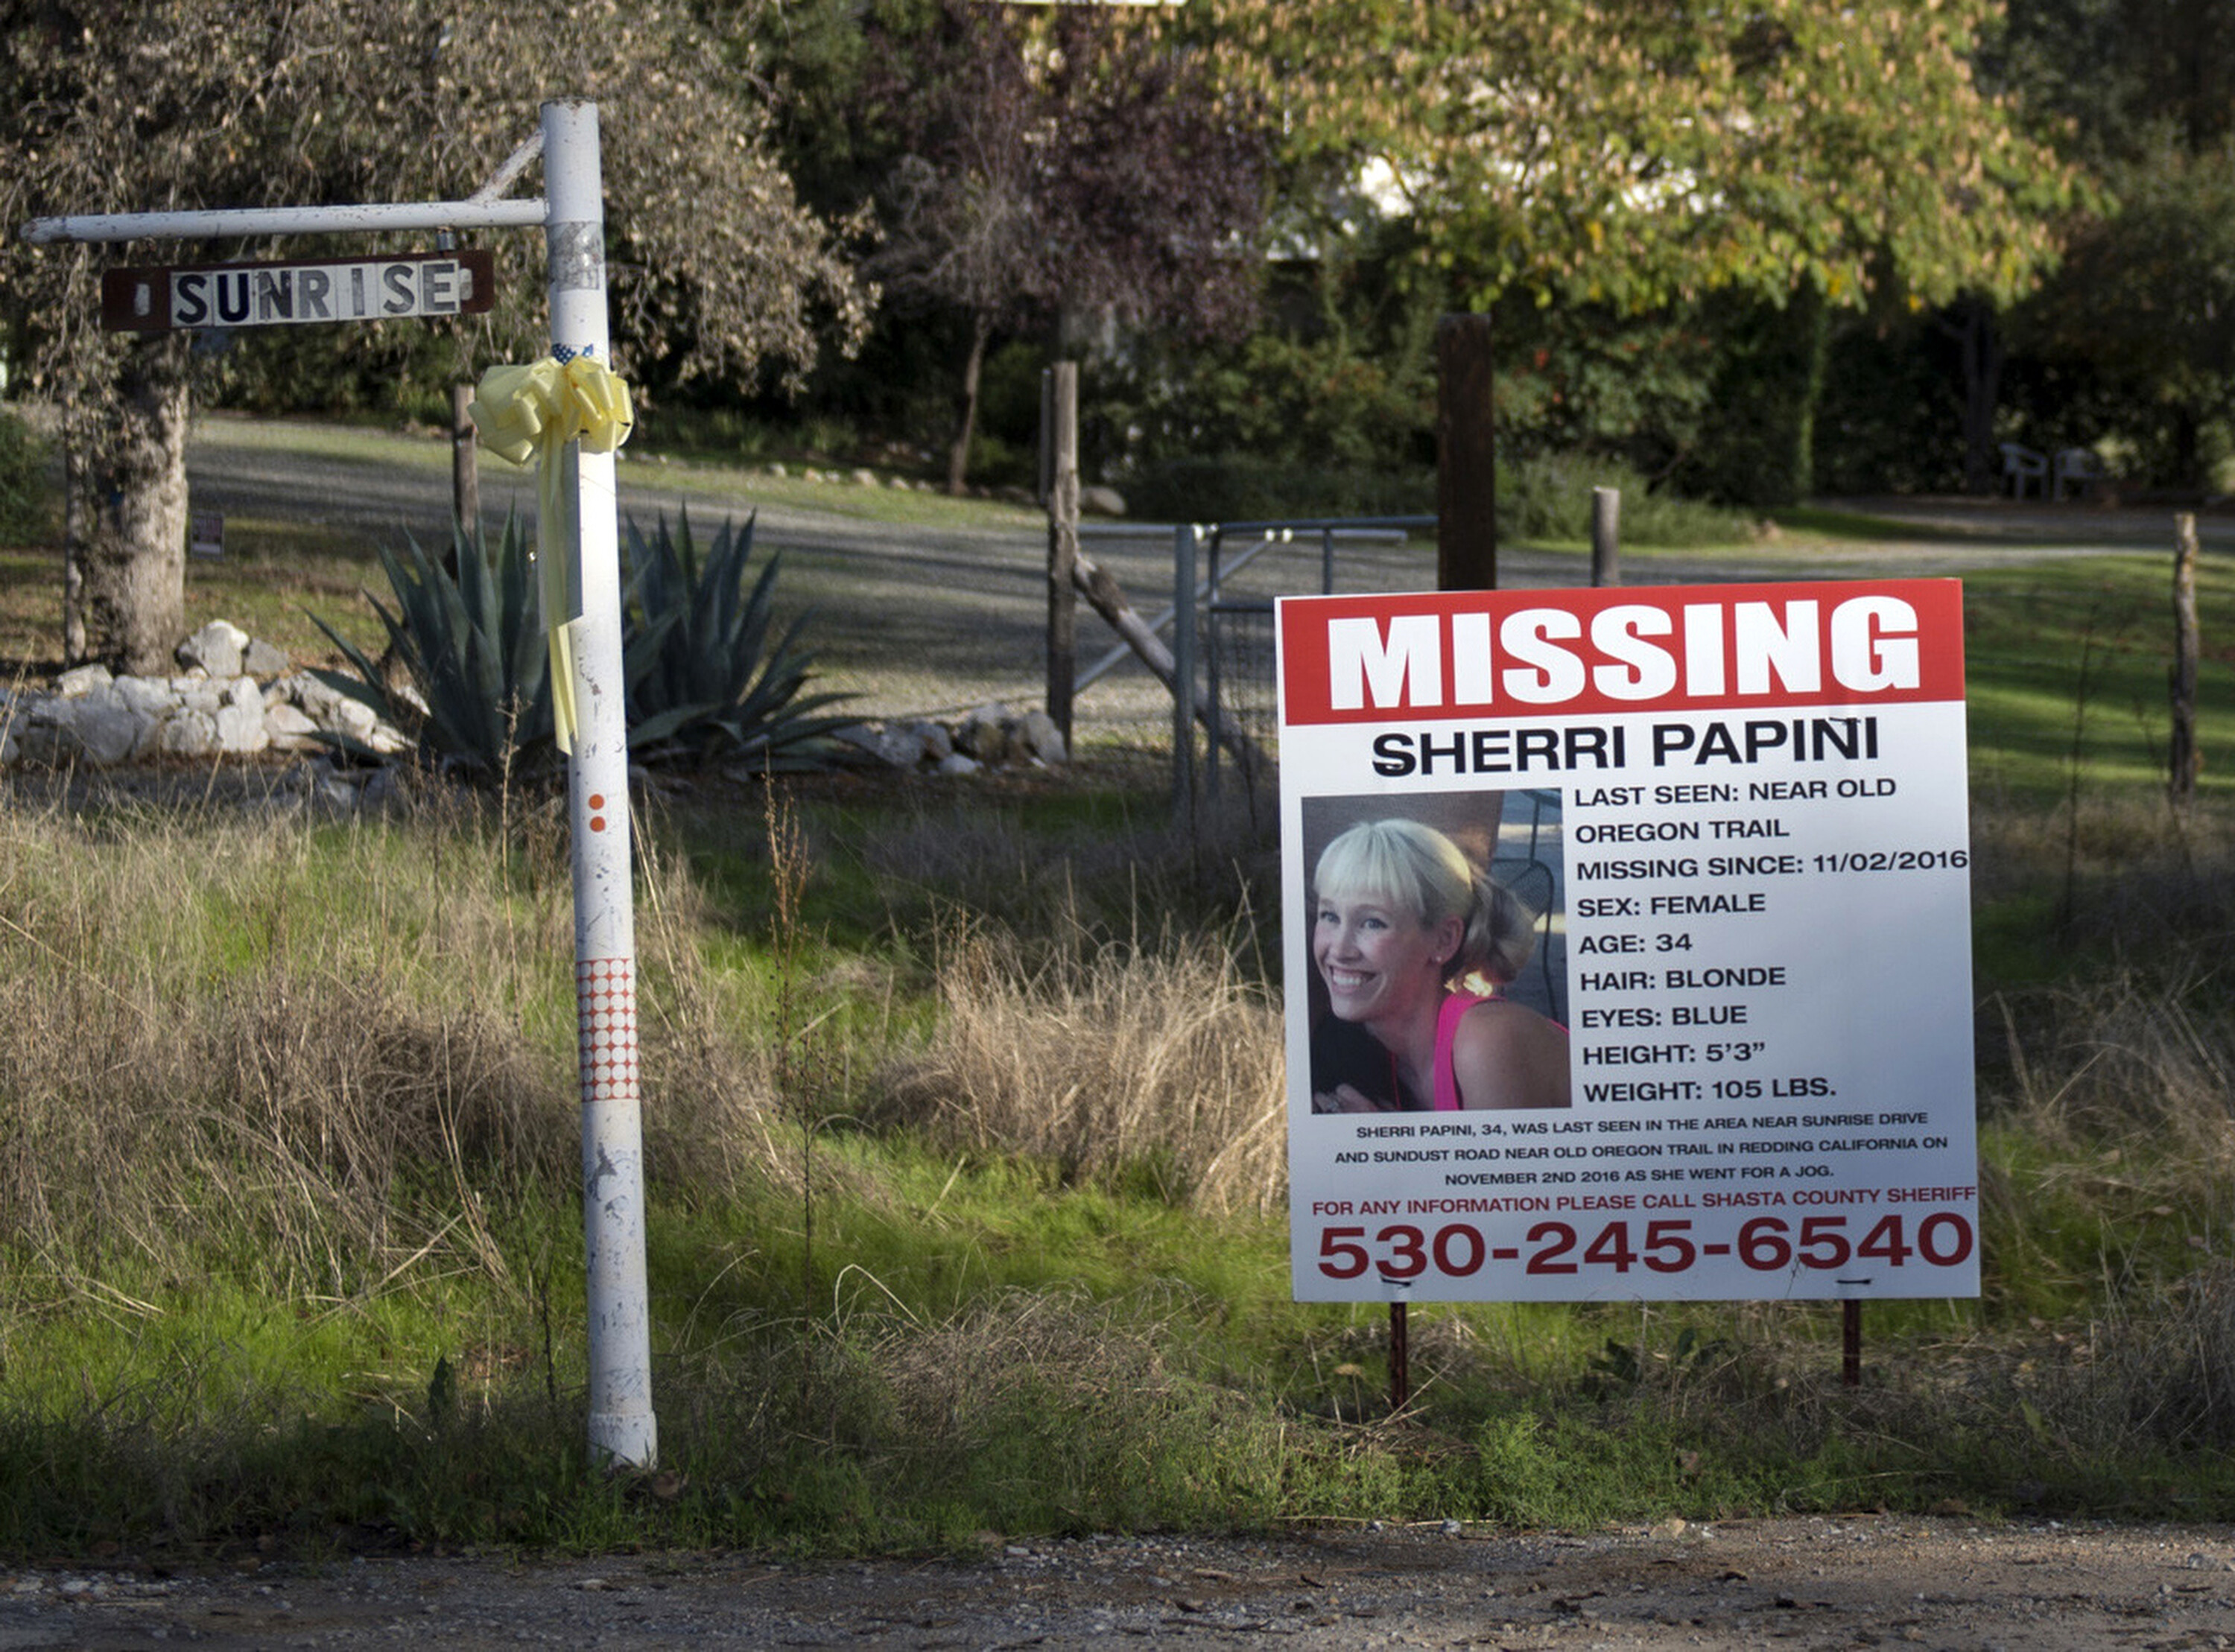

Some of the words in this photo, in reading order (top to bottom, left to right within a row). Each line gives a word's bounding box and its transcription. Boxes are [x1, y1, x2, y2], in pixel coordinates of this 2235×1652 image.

[176, 263, 457, 323] SUNRISE
[1328, 597, 1920, 710] MISSING
[1372, 725, 1626, 778] SHERRI
[1652, 716, 1878, 767] PAPINI
[1574, 787, 1646, 807] LAST
[1654, 784, 1739, 804] SEEN:
[1749, 780, 1827, 801] NEAR
[1836, 778, 1897, 798] OLD
[1575, 822, 1699, 844] OREGON
[1708, 819, 1790, 839] TRAIL
[1577, 858, 1699, 880] MISSING
[1708, 855, 1803, 877] SINCE:
[1813, 850, 1968, 873] 11/02/2016
[1577, 897, 1640, 918] SEX:
[1650, 893, 1766, 915] FEMALE
[1578, 934, 1645, 955] AGE:
[1655, 933, 1693, 953] 34
[1580, 971, 1655, 991] HAIR:
[1666, 967, 1786, 989] BLONDE
[1581, 1008, 1661, 1029] EYES:
[1672, 1005, 1748, 1026] BLUE
[1583, 1044, 1696, 1066] HEIGHT:
[1583, 1081, 1702, 1103] WEIGHT:
[1711, 1079, 1763, 1099] 105
[1772, 1077, 1836, 1098] LBS.
[1356, 1125, 1416, 1139] SHERRI
[1419, 1124, 1477, 1138] PAPINI,
[1481, 1124, 1507, 1137] 34,
[1511, 1122, 1549, 1135] WAS
[1553, 1121, 1594, 1134] LAST
[1597, 1120, 1641, 1134] SEEN
[1645, 1119, 1662, 1131] IN
[1667, 1118, 1699, 1131] THE
[1703, 1117, 1749, 1130] AREA
[1752, 1116, 1798, 1128] NEAR
[1801, 1113, 1874, 1128] SUNRISE
[1879, 1112, 1928, 1125] DRIVE
[1334, 1151, 1369, 1163] AND
[1373, 1149, 1451, 1163] SUNDUST
[1454, 1148, 1501, 1161] ROAD
[1504, 1147, 1550, 1160] NEAR
[1553, 1146, 1588, 1159] OLD
[1591, 1144, 1663, 1158] OREGON
[1666, 1143, 1714, 1156] TRAIL
[1717, 1143, 1734, 1154] IN
[1739, 1140, 1814, 1154] REDDING
[1819, 1137, 1918, 1151] CALIFORNIA
[1922, 1137, 1948, 1149] ON
[1445, 1172, 1538, 1186] NOVEMBER
[1541, 1171, 1576, 1184] 2ND
[1580, 1170, 1620, 1183] 2016
[1624, 1169, 1647, 1182] AS
[1650, 1169, 1684, 1181] SHE
[1688, 1167, 1737, 1180] WENT
[1741, 1166, 1775, 1179] FOR
[1779, 1166, 1792, 1178] A
[1795, 1165, 1834, 1178] JOG.
[1312, 1201, 1354, 1216] FOR
[1359, 1200, 1401, 1216] ANY
[1407, 1196, 1550, 1214] INFORMATION
[1556, 1195, 1637, 1211] PLEASE
[1642, 1193, 1696, 1210] CALL
[1702, 1191, 1787, 1208] SHASTA
[1792, 1189, 1880, 1206] COUNTY
[1887, 1186, 1976, 1203] SHERIFF
[1318, 1213, 1974, 1279] 530-245-6540
